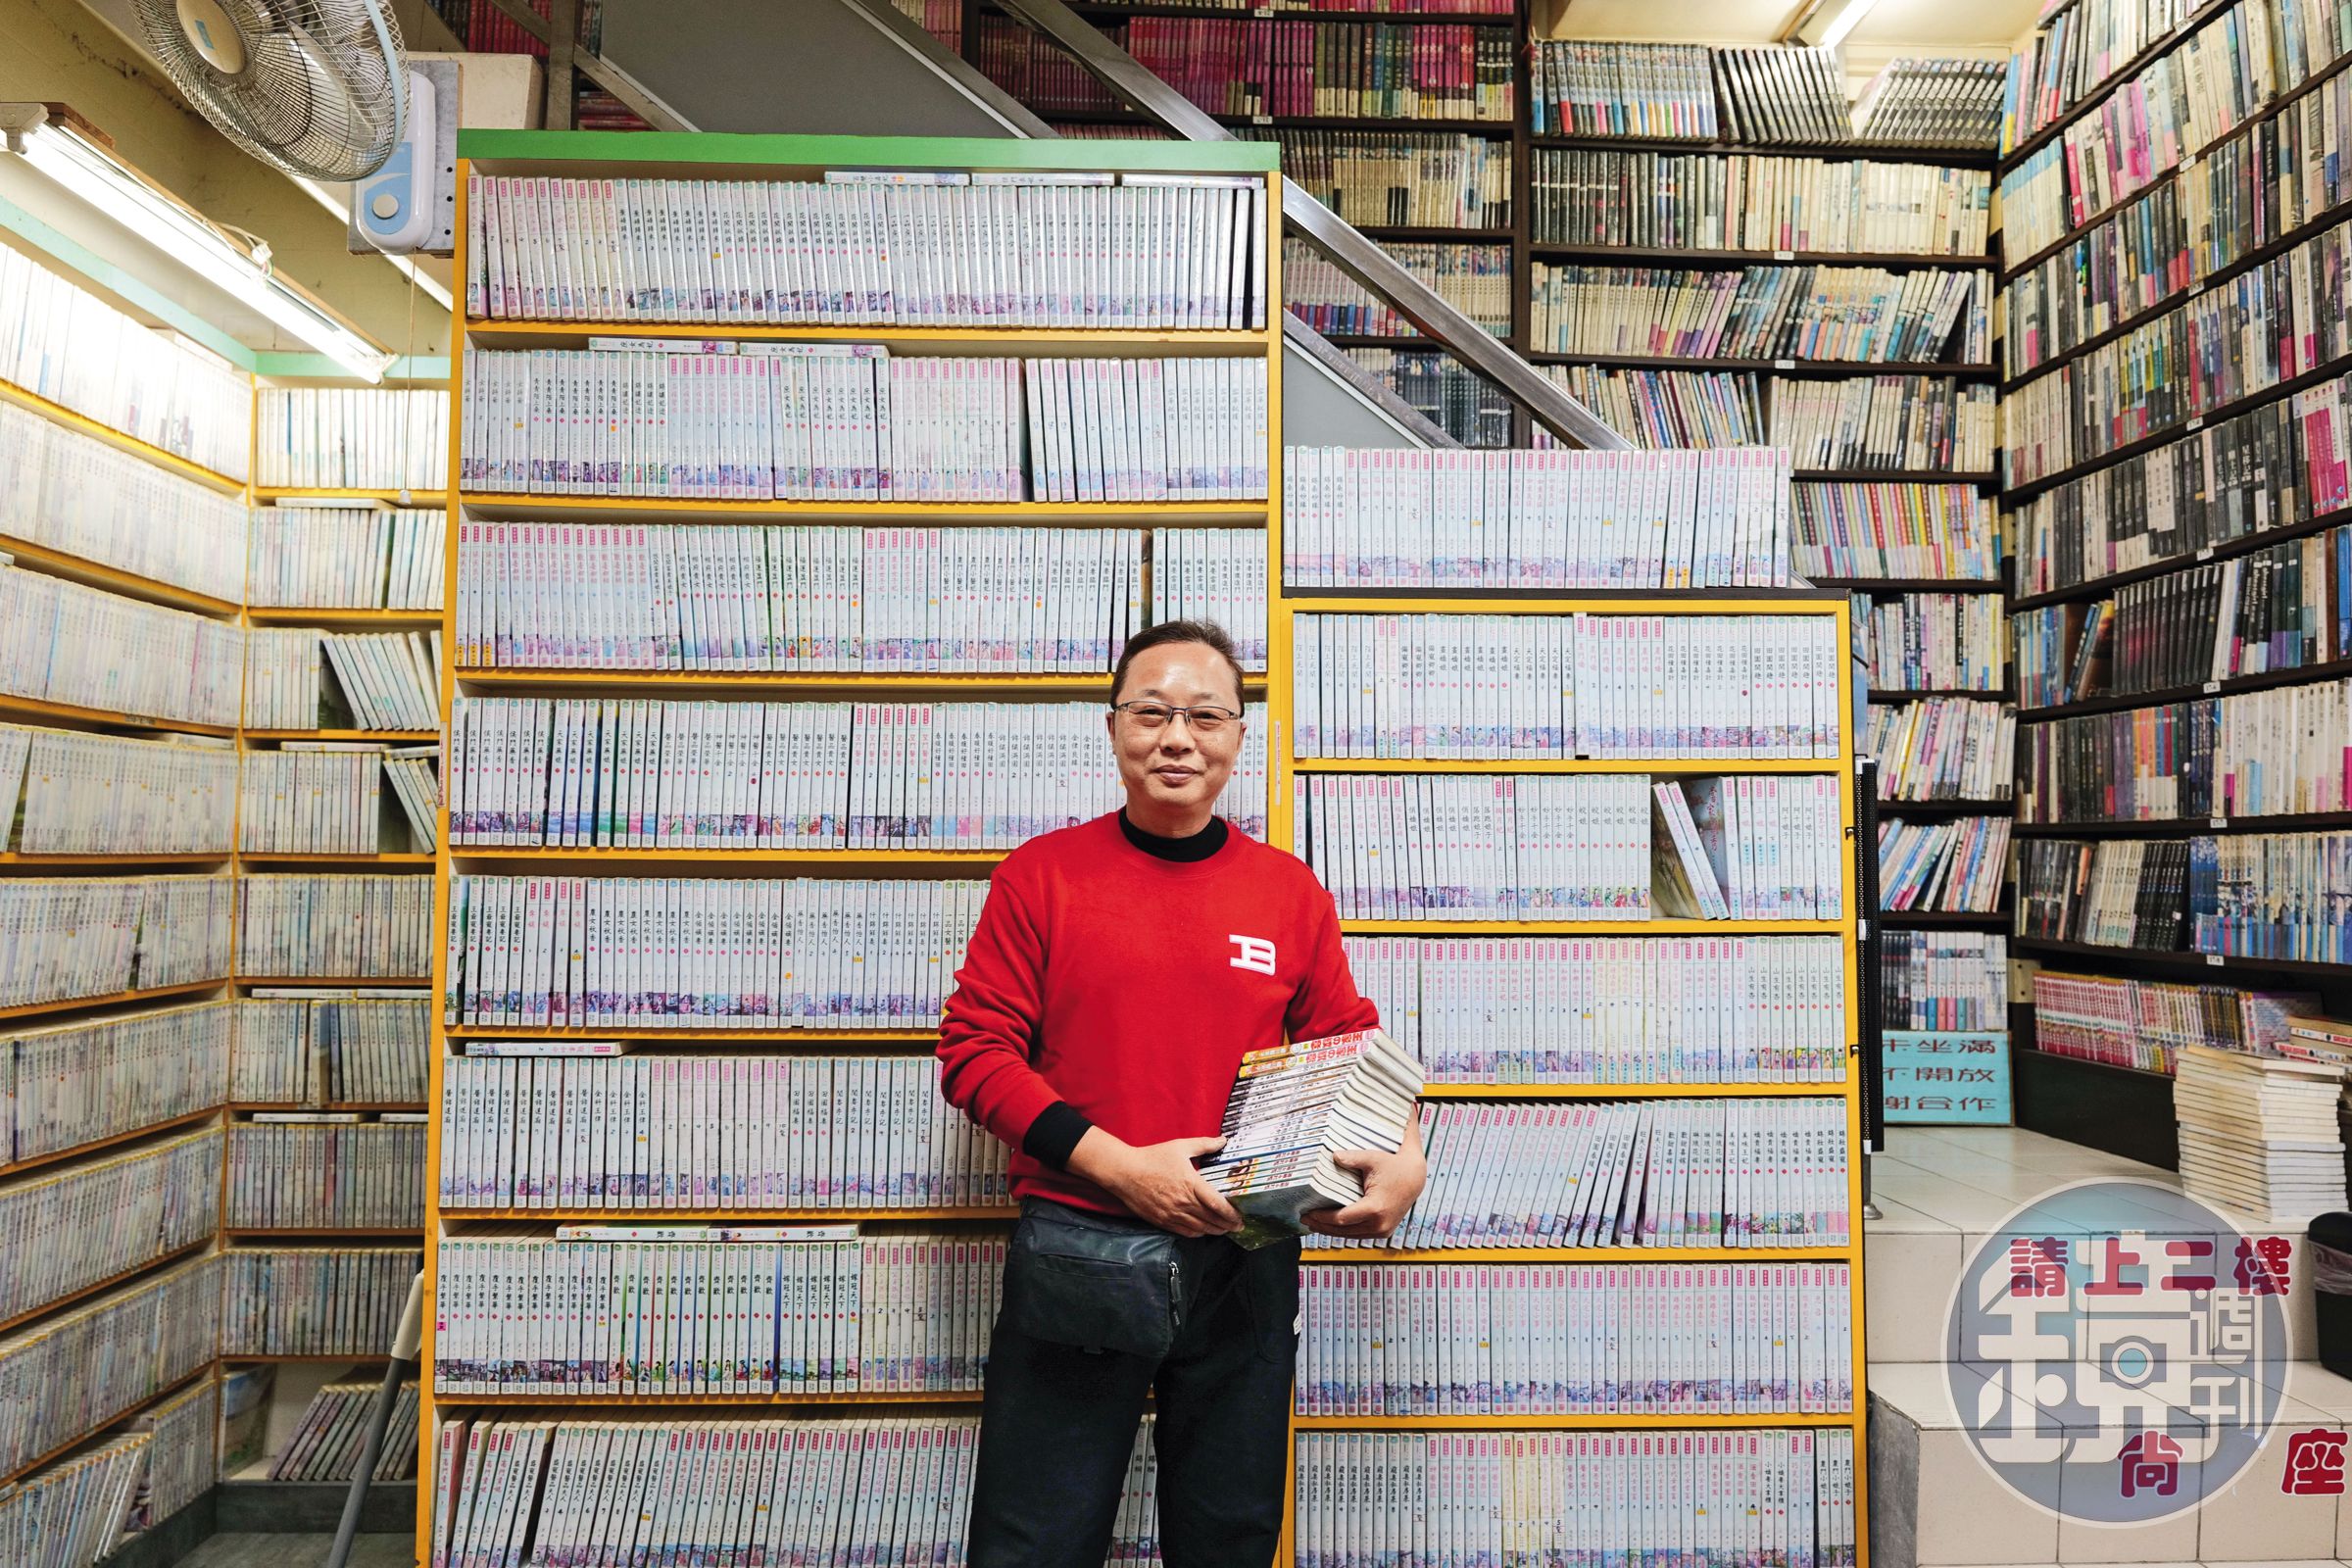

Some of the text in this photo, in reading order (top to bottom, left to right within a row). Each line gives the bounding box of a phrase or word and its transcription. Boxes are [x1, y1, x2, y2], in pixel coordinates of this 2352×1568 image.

[2009, 1236, 2292, 1298] 請上二樓
[2280, 1428, 2348, 1496] 座
